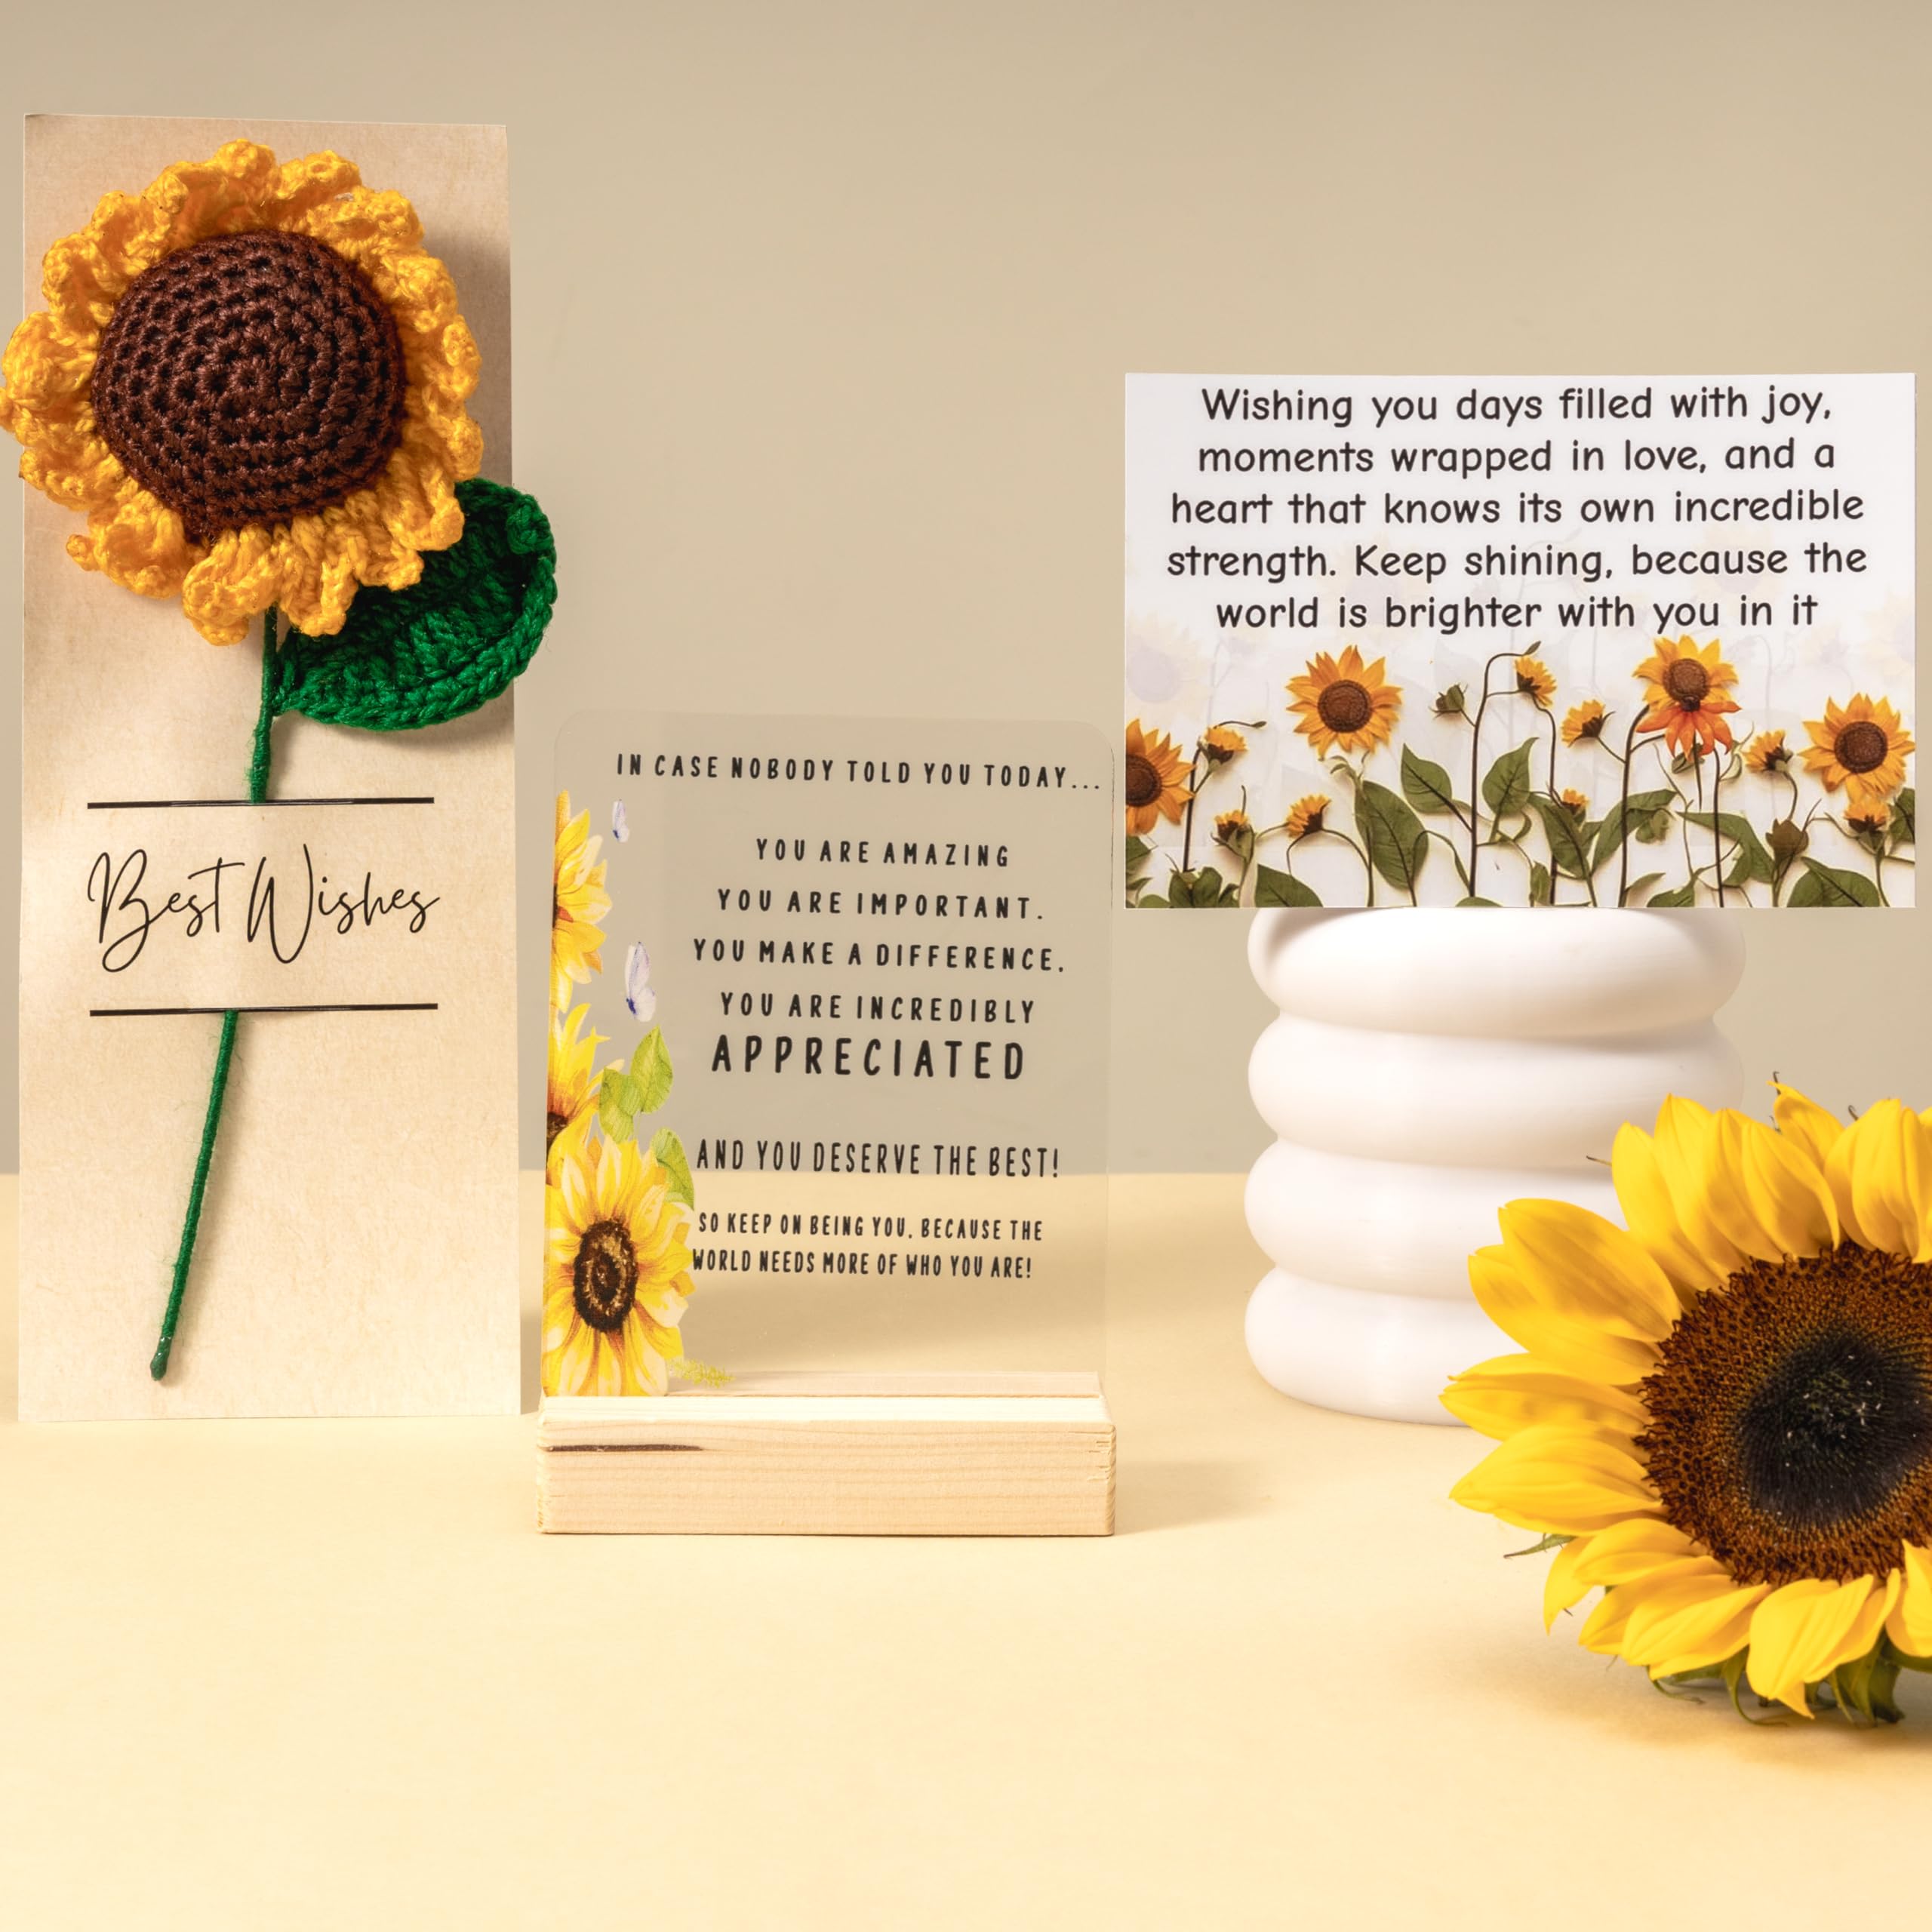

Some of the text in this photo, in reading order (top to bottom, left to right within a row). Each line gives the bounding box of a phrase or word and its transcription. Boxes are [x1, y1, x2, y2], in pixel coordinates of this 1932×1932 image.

[1201, 385, 1830, 428] Wishing you days filled with joy,
[1199, 437, 1834, 479] moments wrapped in love, and a
[1172, 488, 1863, 525] heart that knows its own incredible
[1168, 542, 1867, 584] strength. Keep shining, because the
[1217, 594, 1818, 635] world is brighter with you in it
[617, 753, 1100, 789] IN CASE NOBODY TOLD YOU TODAY...
[756, 838, 1008, 867] YOU ARE AMAZING
[88, 844, 440, 973] Best Wishes
[718, 888, 1042, 919] YOU ARE IMPORTANT.
[694, 938, 744, 962] YOU
[759, 940, 834, 965] MAKE
[848, 943, 861, 965] A
[721, 992, 1034, 1024] YOU ARE INCREDIBLY
[711, 1034, 1023, 1080] APPRECIATED
[697, 1139, 1058, 1178] AND YOU DESERVE THE BEST!
[699, 1212, 718, 1232] SO
[728, 1213, 771, 1234] KEEP
[780, 1214, 801, 1235] ON
[810, 1215, 863, 1236] BEING
[921, 1218, 1001, 1240] BECAUSE
[1010, 1220, 1042, 1241] THE
[693, 1249, 1031, 1278] WORLD NEEDS MORE OF WHO YOU ARE!
